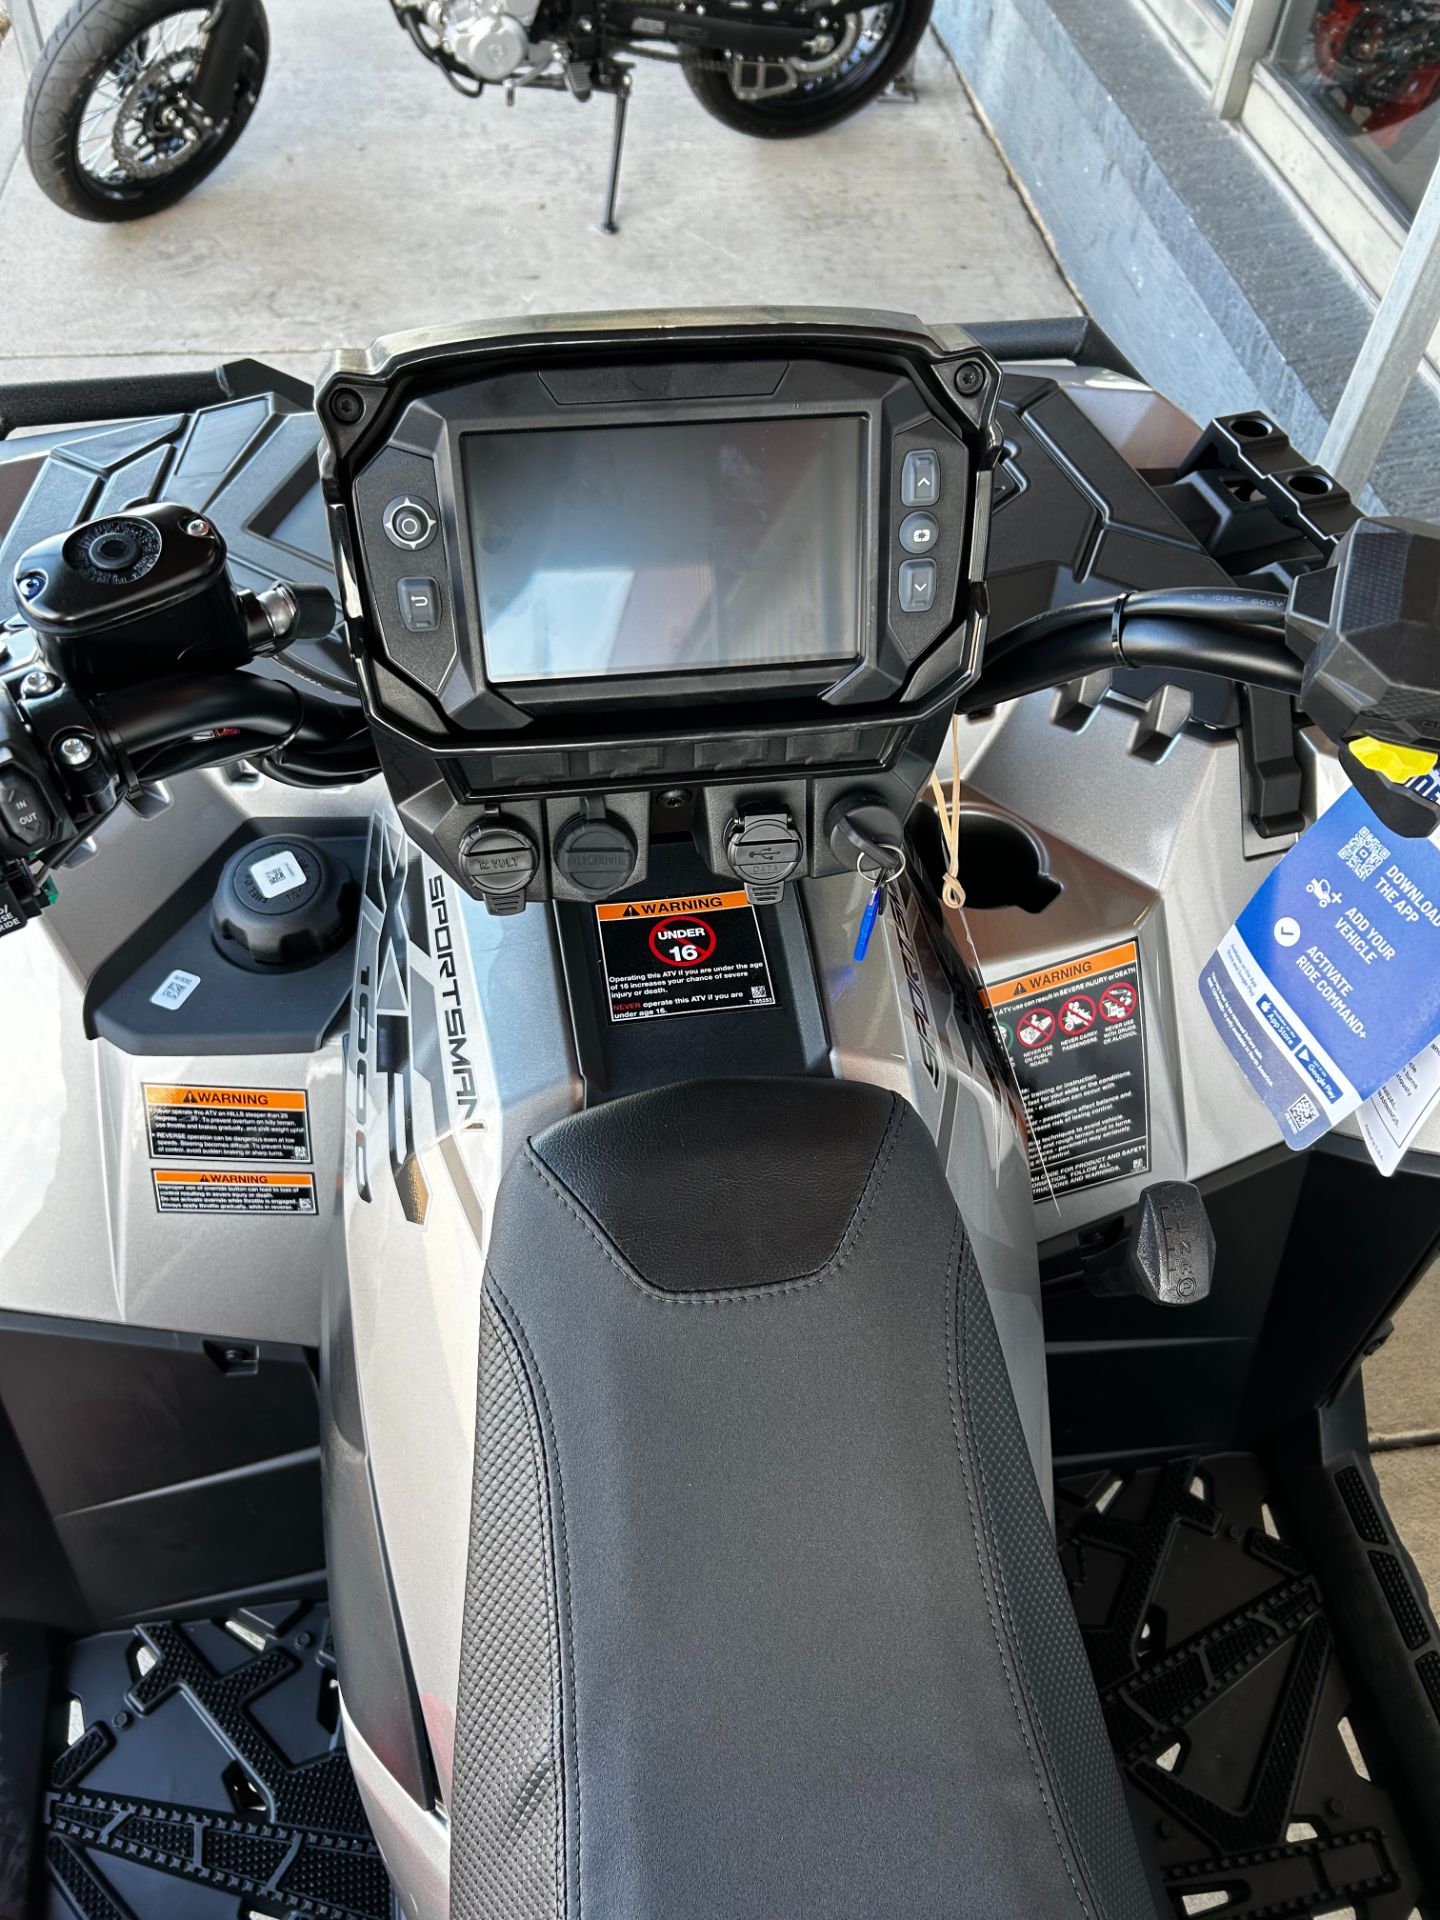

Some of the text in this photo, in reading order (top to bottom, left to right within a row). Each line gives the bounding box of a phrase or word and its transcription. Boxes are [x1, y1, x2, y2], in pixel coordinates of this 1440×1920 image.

[16, 800, 27, 810] IN
[19, 813, 38, 825] OUT
[491, 856, 520, 869] VOLT
[640, 896, 723, 914] WARNING
[1373, 876, 1420, 925] THE APP
[1385, 864, 1440, 928] DOWNLOAD
[656, 927, 705, 940] UNDER
[1333, 916, 1378, 965] VEHICLE
[1344, 905, 1397, 961] ADD YOUR
[668, 944, 698, 961] 16
[609, 973, 645, 984] Operating
[713, 964, 731, 972] under
[1029, 960, 1092, 989] WARNING
[1306, 944, 1353, 997] ACTIVATE
[629, 979, 666, 988] increases
[685, 974, 713, 982] chance
[611, 990, 632, 999] injury
[643, 987, 668, 995] death.
[998, 966, 1135, 1015] ATV use can result in SEVERE INJURY or DEATH
[1295, 954, 1369, 1040] RIDE COMMAND+
[428, 874, 487, 1131] SPORTSMAN
[613, 1002, 641, 1011] NEVER
[642, 999, 673, 1008] operate
[714, 993, 729, 1001] you
[614, 1010, 637, 1018] under
[638, 1009, 654, 1017] age
[1104, 1018, 1134, 1032] NEVER USE
[1266, 1012, 1294, 1045] App Store
[1060, 1030, 1097, 1046] NEVER CARRY
[1023, 1044, 1053, 1057] NEVER USE
[1029, 1057, 1048, 1067] ROADS
[1306, 1062, 1337, 1100] Google Play
[197, 1092, 268, 1104] WARNING
[1059, 1143, 1145, 1173] FOR PRODUCT AND SAFETY
[211, 1174, 267, 1183] WARNING
[1069, 1165, 1097, 1177] FOLLOW
[1069, 1175, 1083, 1183] AND
[1084, 1164, 1120, 1179] WARNINGS.
